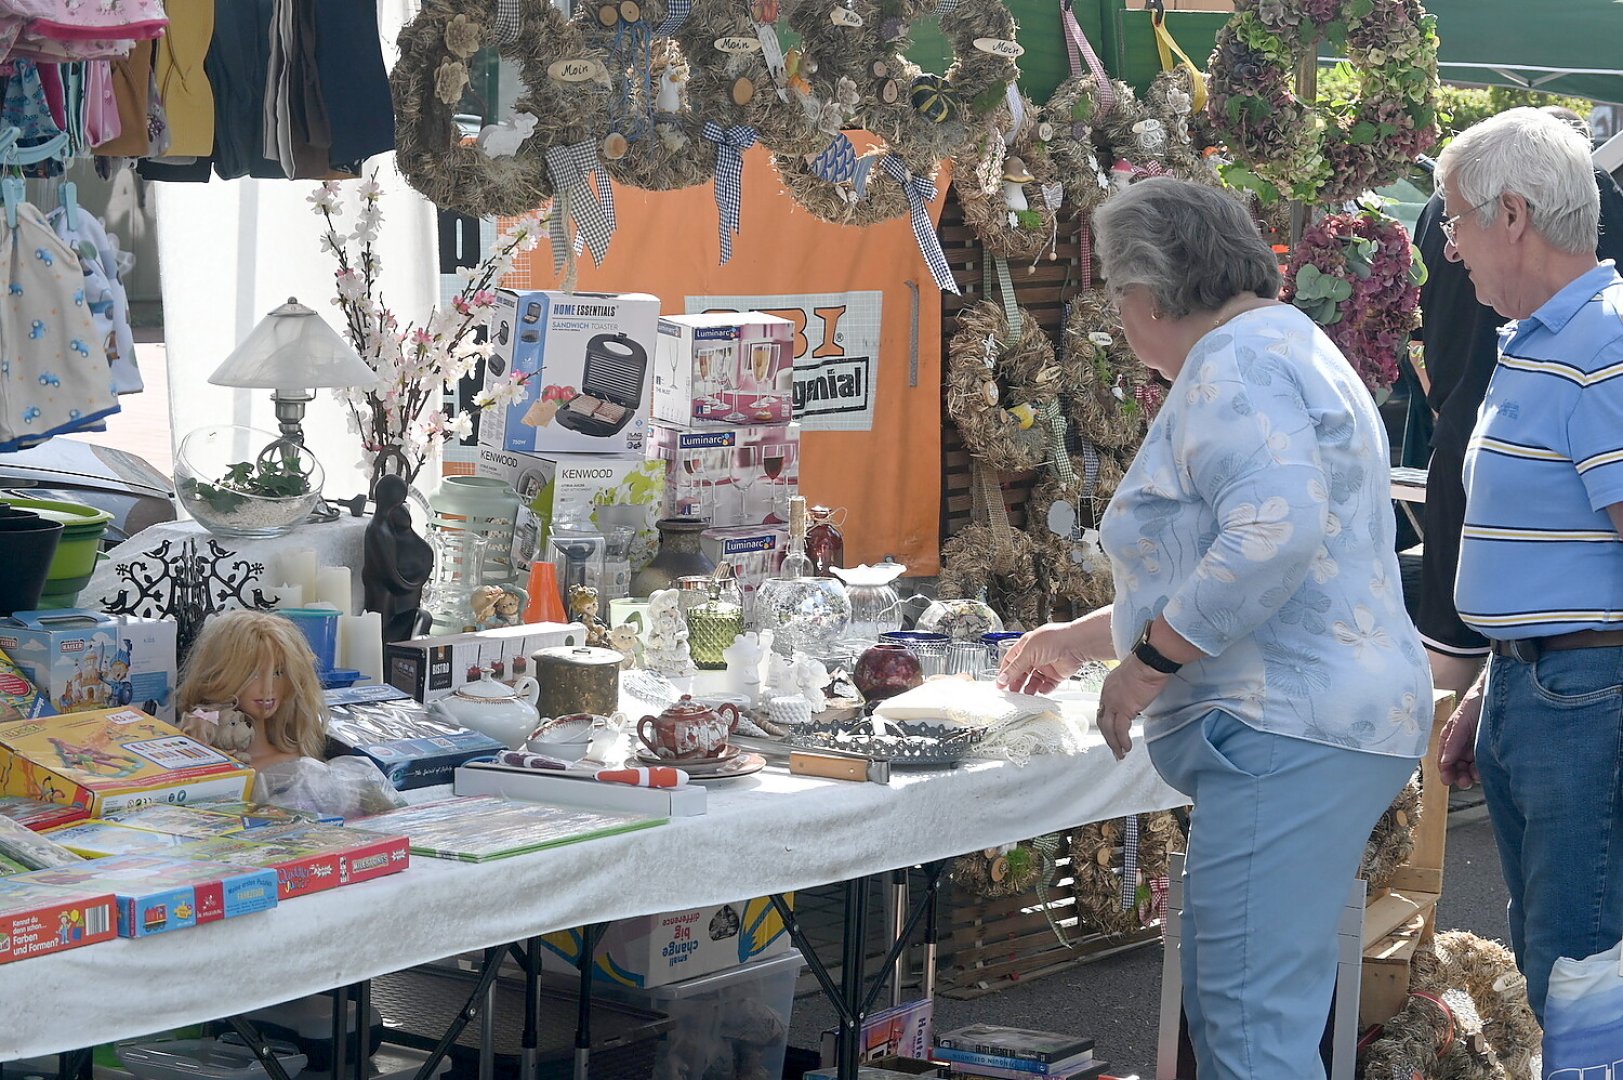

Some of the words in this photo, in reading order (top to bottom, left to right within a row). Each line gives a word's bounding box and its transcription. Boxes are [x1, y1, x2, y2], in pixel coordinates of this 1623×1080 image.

[843, 11, 860, 25] Moin
[720, 38, 750, 50] Moin
[992, 41, 1019, 55] Moin
[561, 64, 589, 77] Moin
[553, 304, 575, 316] HOME
[576, 304, 616, 317] ESSENTIALS
[551, 321, 590, 330] SANDWICH
[591, 322, 619, 331] TOASTER
[696, 330, 730, 338] Luminarc
[682, 436, 722, 446] Luminarc
[480, 450, 518, 468] KENWOOD
[561, 468, 613, 479] KENWOOD
[727, 540, 764, 551] Luminarc
[432, 662, 450, 675] BISTRO
[12, 918, 30, 927] Kennst
[662, 912, 700, 926] difference
[12, 927, 27, 935] denn
[674, 925, 691, 940] big
[13, 933, 38, 945] Farben
[13, 945, 28, 956] und
[28, 937, 59, 952] Formen?
[662, 940, 699, 957] change
[669, 954, 688, 967] small
